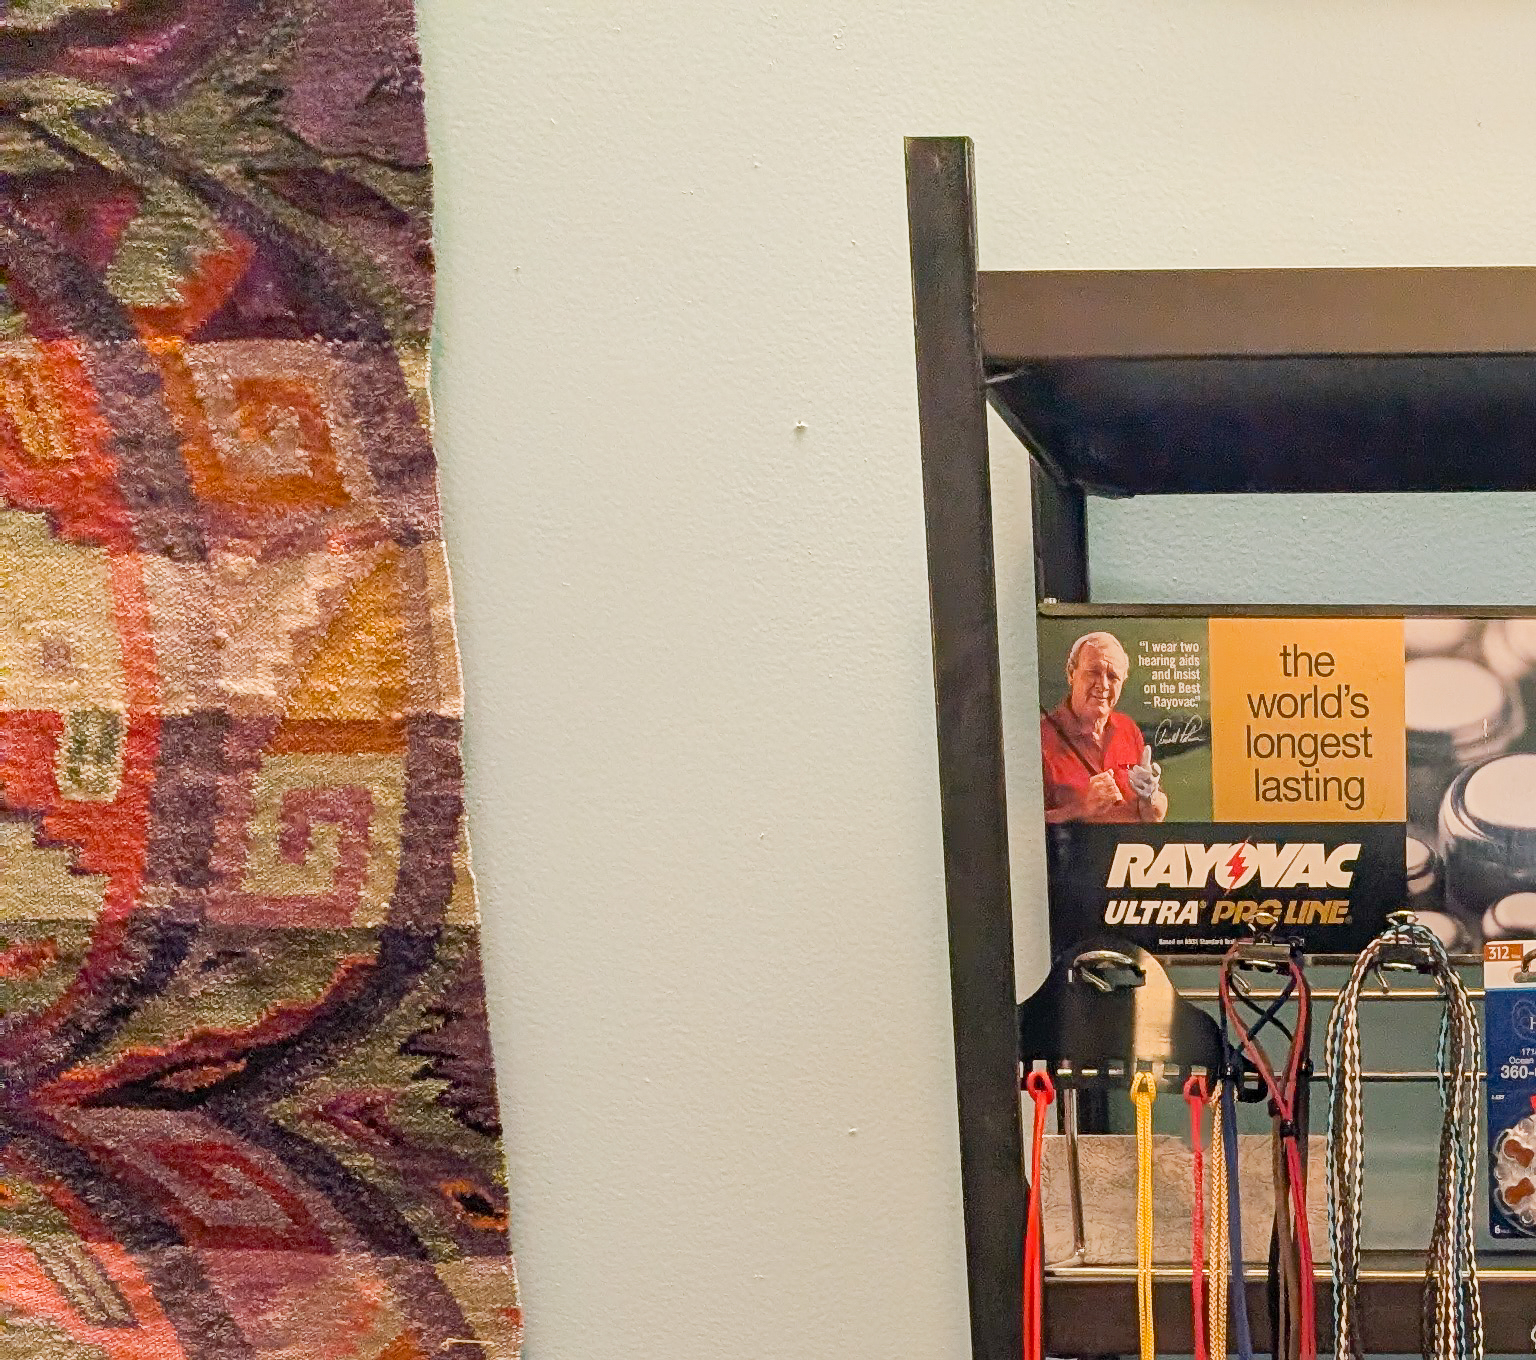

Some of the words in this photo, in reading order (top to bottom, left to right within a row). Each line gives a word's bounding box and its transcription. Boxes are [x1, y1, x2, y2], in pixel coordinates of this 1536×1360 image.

[1152, 642, 1177, 652] wear
[1180, 641, 1200, 652] two
[1138, 654, 1176, 668] hearing
[1179, 654, 1200, 666] aids
[1279, 644, 1335, 677] the
[1152, 668, 1171, 680] and
[1144, 684, 1156, 694] on
[1160, 682, 1176, 694] the
[1178, 682, 1201, 694] Best
[1246, 685, 1370, 718] world's
[1245, 725, 1373, 767] longest
[1254, 770, 1366, 810] lasting
[1106, 842, 1362, 889] RAYOVAC
[1488, 945, 1510, 960] 312
